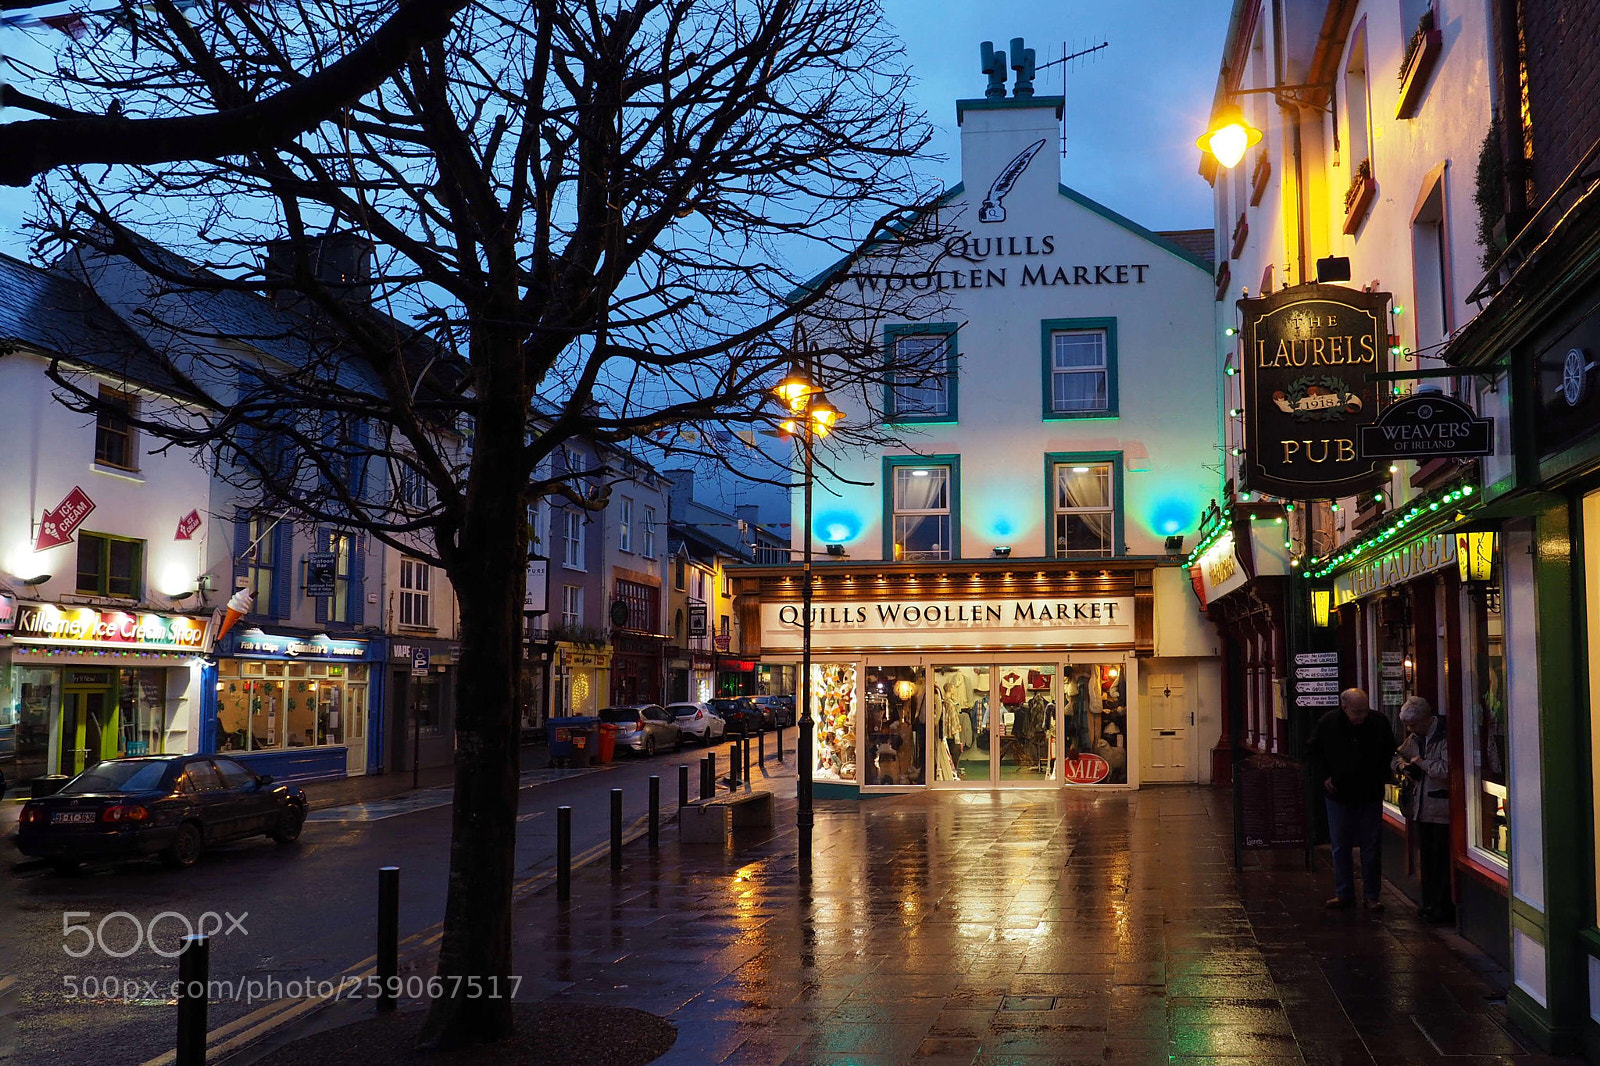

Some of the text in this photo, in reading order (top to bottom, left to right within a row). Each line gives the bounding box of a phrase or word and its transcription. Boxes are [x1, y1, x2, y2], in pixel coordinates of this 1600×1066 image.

[989, 208, 1001, 217] Q
[944, 235, 1055, 261] QUILLS
[853, 263, 1149, 292] WOOLLEN MARKET
[1293, 315, 1338, 328] THE
[1257, 334, 1375, 369] LAURELS
[1304, 399, 1334, 410] 1918
[1381, 422, 1471, 441] WEAVERS
[1281, 438, 1356, 464] PUB
[1394, 439, 1456, 451] OF IRELAND
[58, 500, 74, 518] ICE
[59, 501, 88, 532] CREAM
[1347, 533, 1455, 596] THE LAUREL
[779, 602, 1119, 628] QUILLS WOOLLEN MARKET
[19, 609, 202, 645] Killarney Ice Cream Shop
[241, 642, 253, 650] Fish
[284, 641, 328, 656] Quinlan's
[393, 645, 410, 658] VAPE
[414, 659, 427, 668] P
[1067, 759, 1102, 779] SALE
